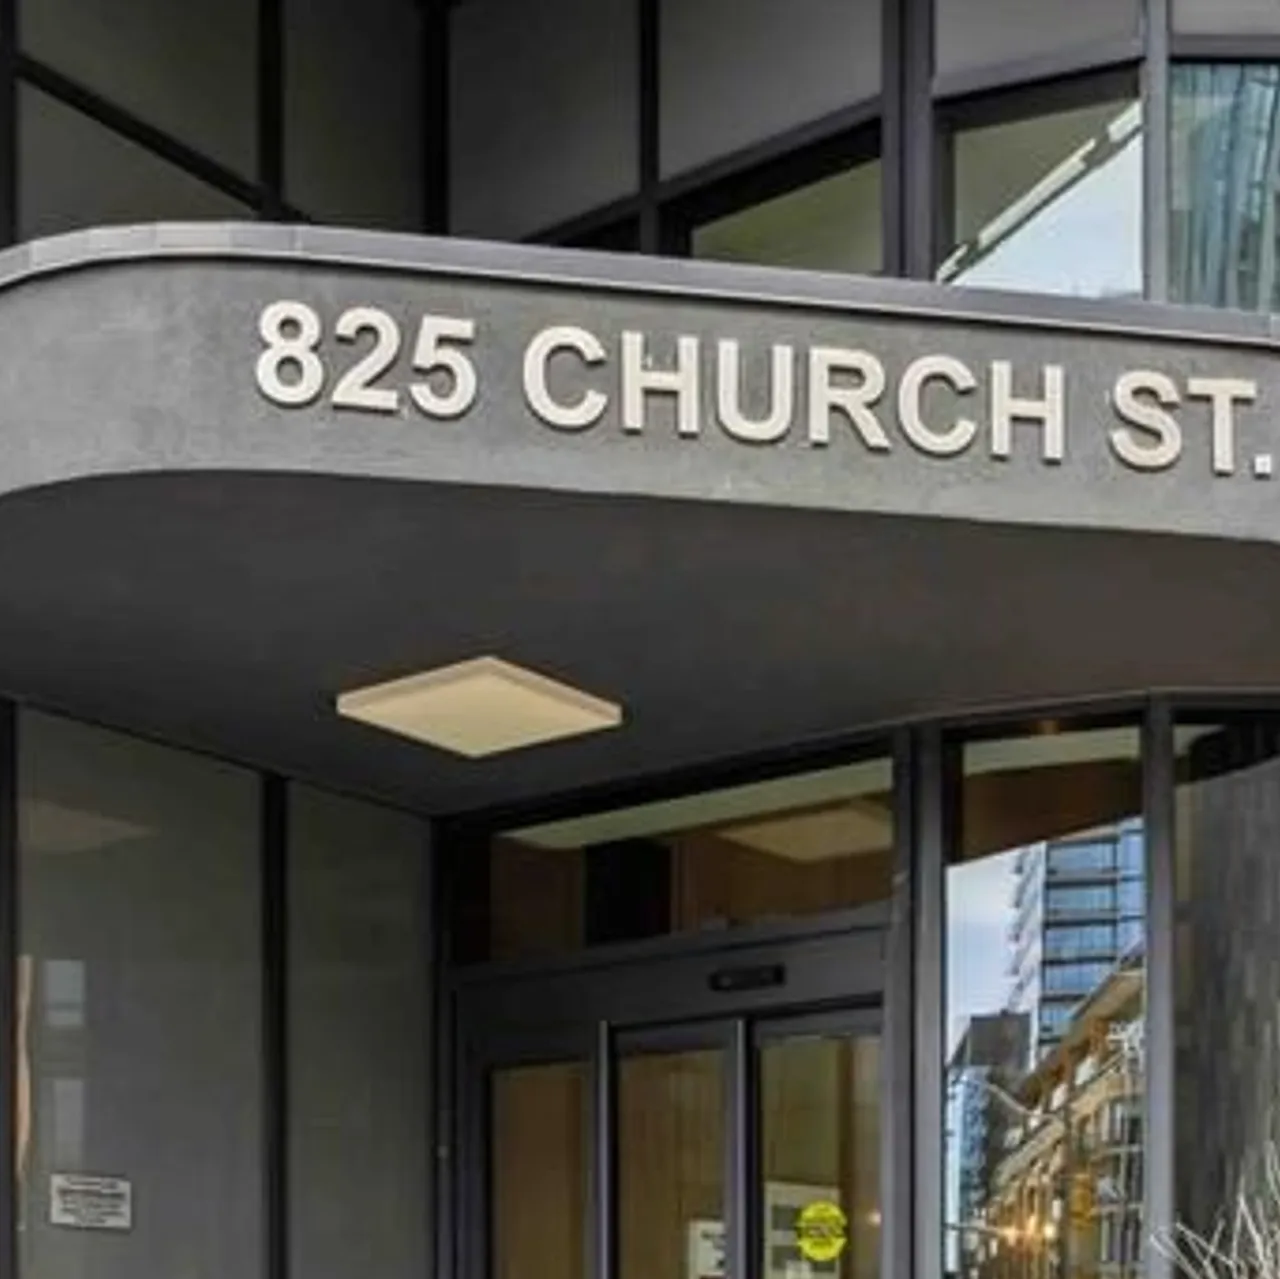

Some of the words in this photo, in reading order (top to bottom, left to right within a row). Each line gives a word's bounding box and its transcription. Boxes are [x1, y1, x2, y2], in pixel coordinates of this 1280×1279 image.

[253, 299, 479, 419] 825
[521, 325, 1065, 461] CHURCH
[1109, 370, 1273, 479] ST.
